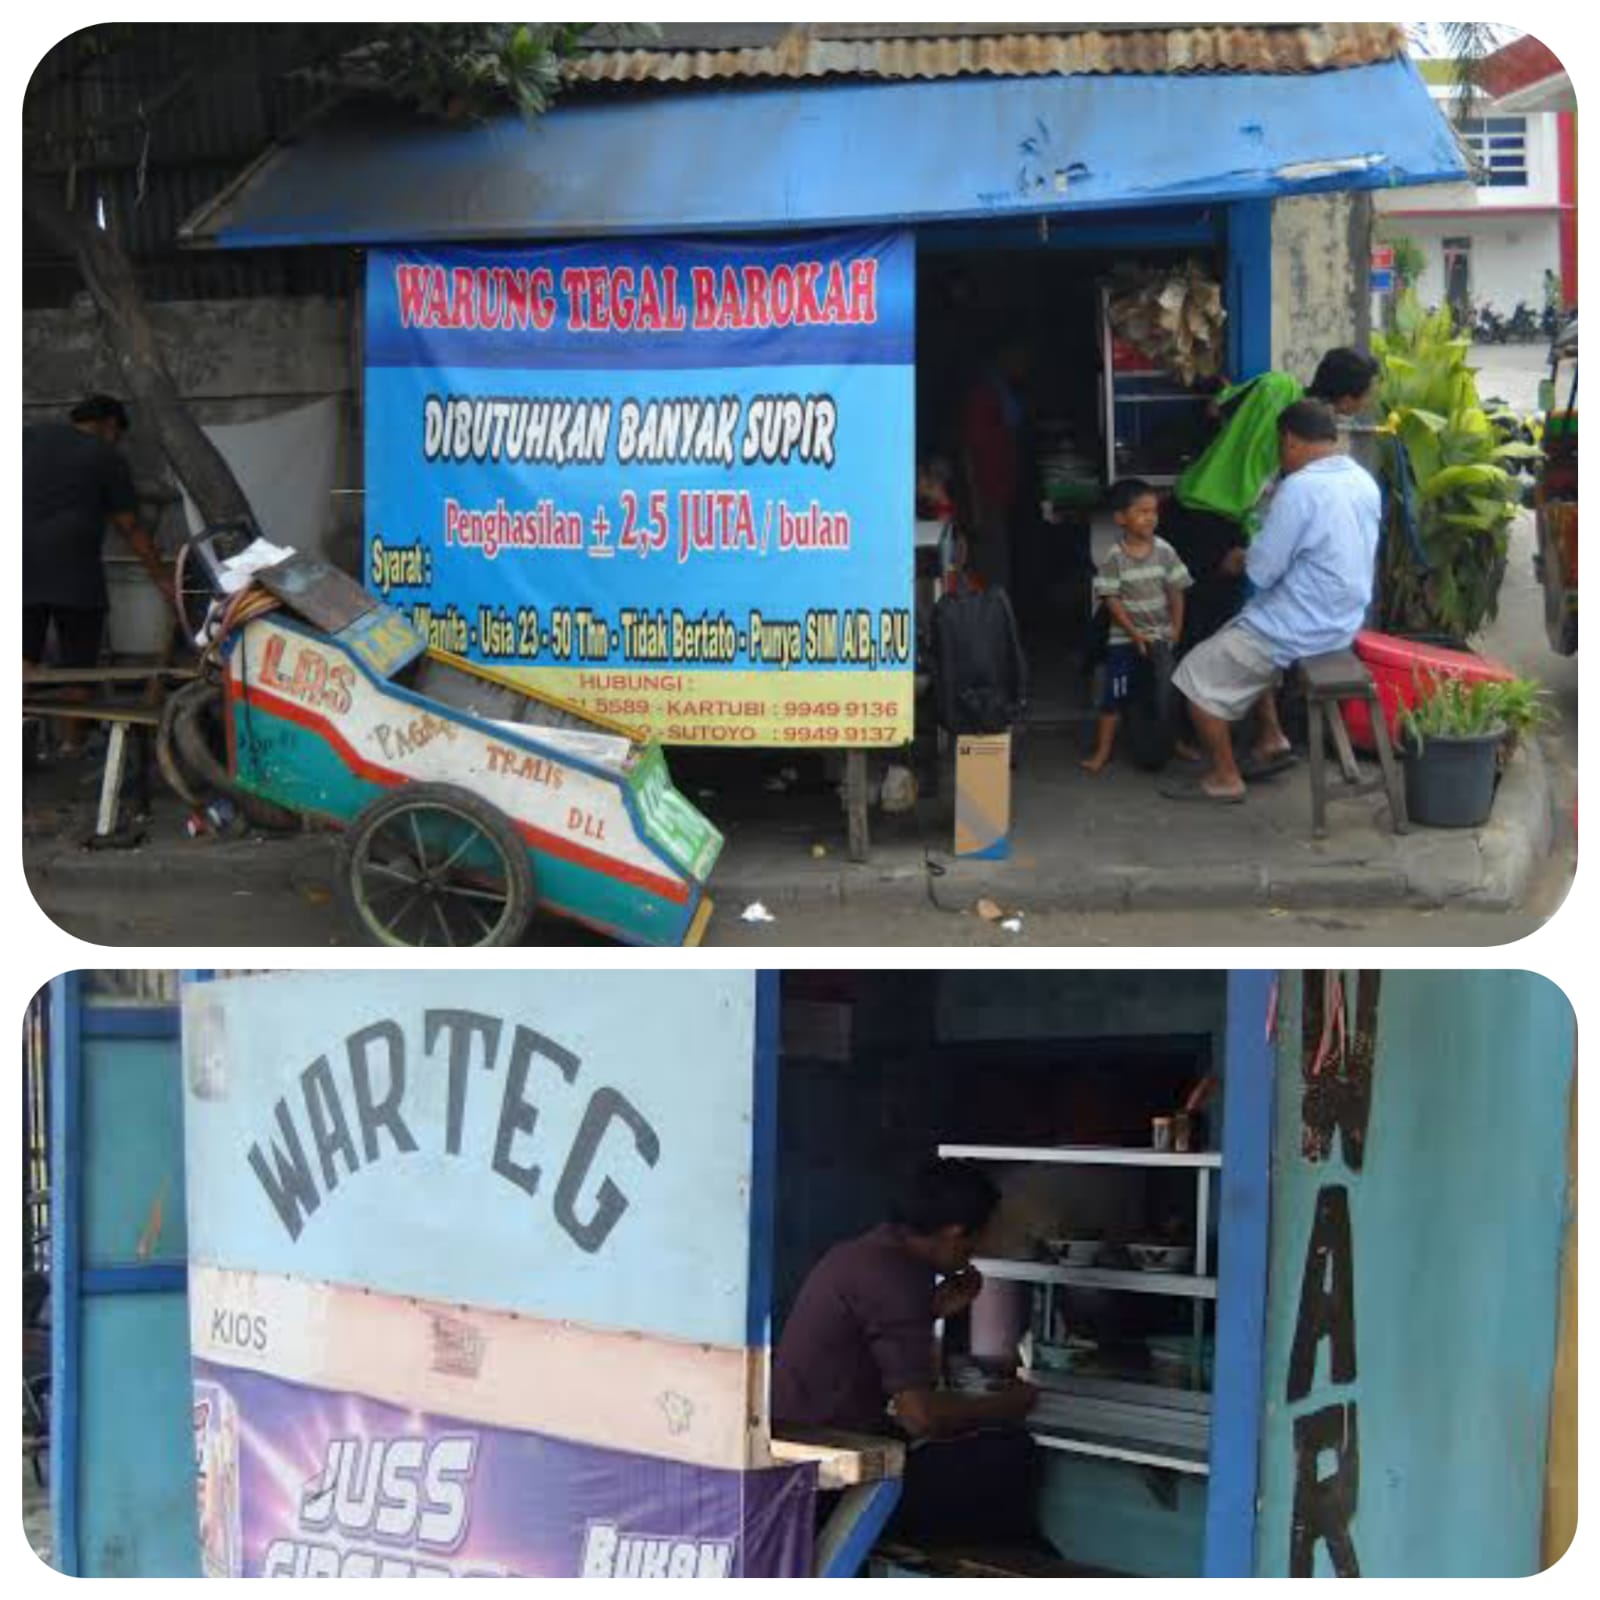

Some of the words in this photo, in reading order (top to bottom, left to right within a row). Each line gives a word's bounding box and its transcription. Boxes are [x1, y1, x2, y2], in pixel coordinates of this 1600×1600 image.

[397, 264, 556, 330] WARUNG
[562, 265, 686, 331] TEGAL
[691, 257, 878, 330] BAROKAH
[424, 395, 612, 467] DIBUTUHKAN
[618, 396, 741, 468] BANYAK
[741, 394, 837, 469] SUPIR
[445, 498, 583, 559] Penghasilan
[618, 489, 669, 559] 2,5
[677, 489, 757, 563] JUTA
[778, 499, 850, 552] bulan
[480, 605, 515, 657] Usia
[517, 605, 540, 658] 23
[551, 606, 573, 660] 50
[620, 608, 670, 662] Tidak
[671, 607, 736, 662] Bertato
[750, 608, 801, 671] Punya
[806, 608, 838, 662] SIM
[580, 672, 682, 691] HUBUNGI
[668, 700, 765, 716] KARTUBI
[784, 702, 841, 717] 9949
[845, 702, 898, 717] 9136
[668, 724, 757, 740] SUTOYO
[783, 727, 839, 742] 9949
[844, 727, 897, 742] 9137
[566, 806, 605, 842] DLL
[247, 1008, 660, 1254] WARTEG
[210, 1308, 268, 1350] KIOS
[301, 1437, 477, 1553] JUSS
